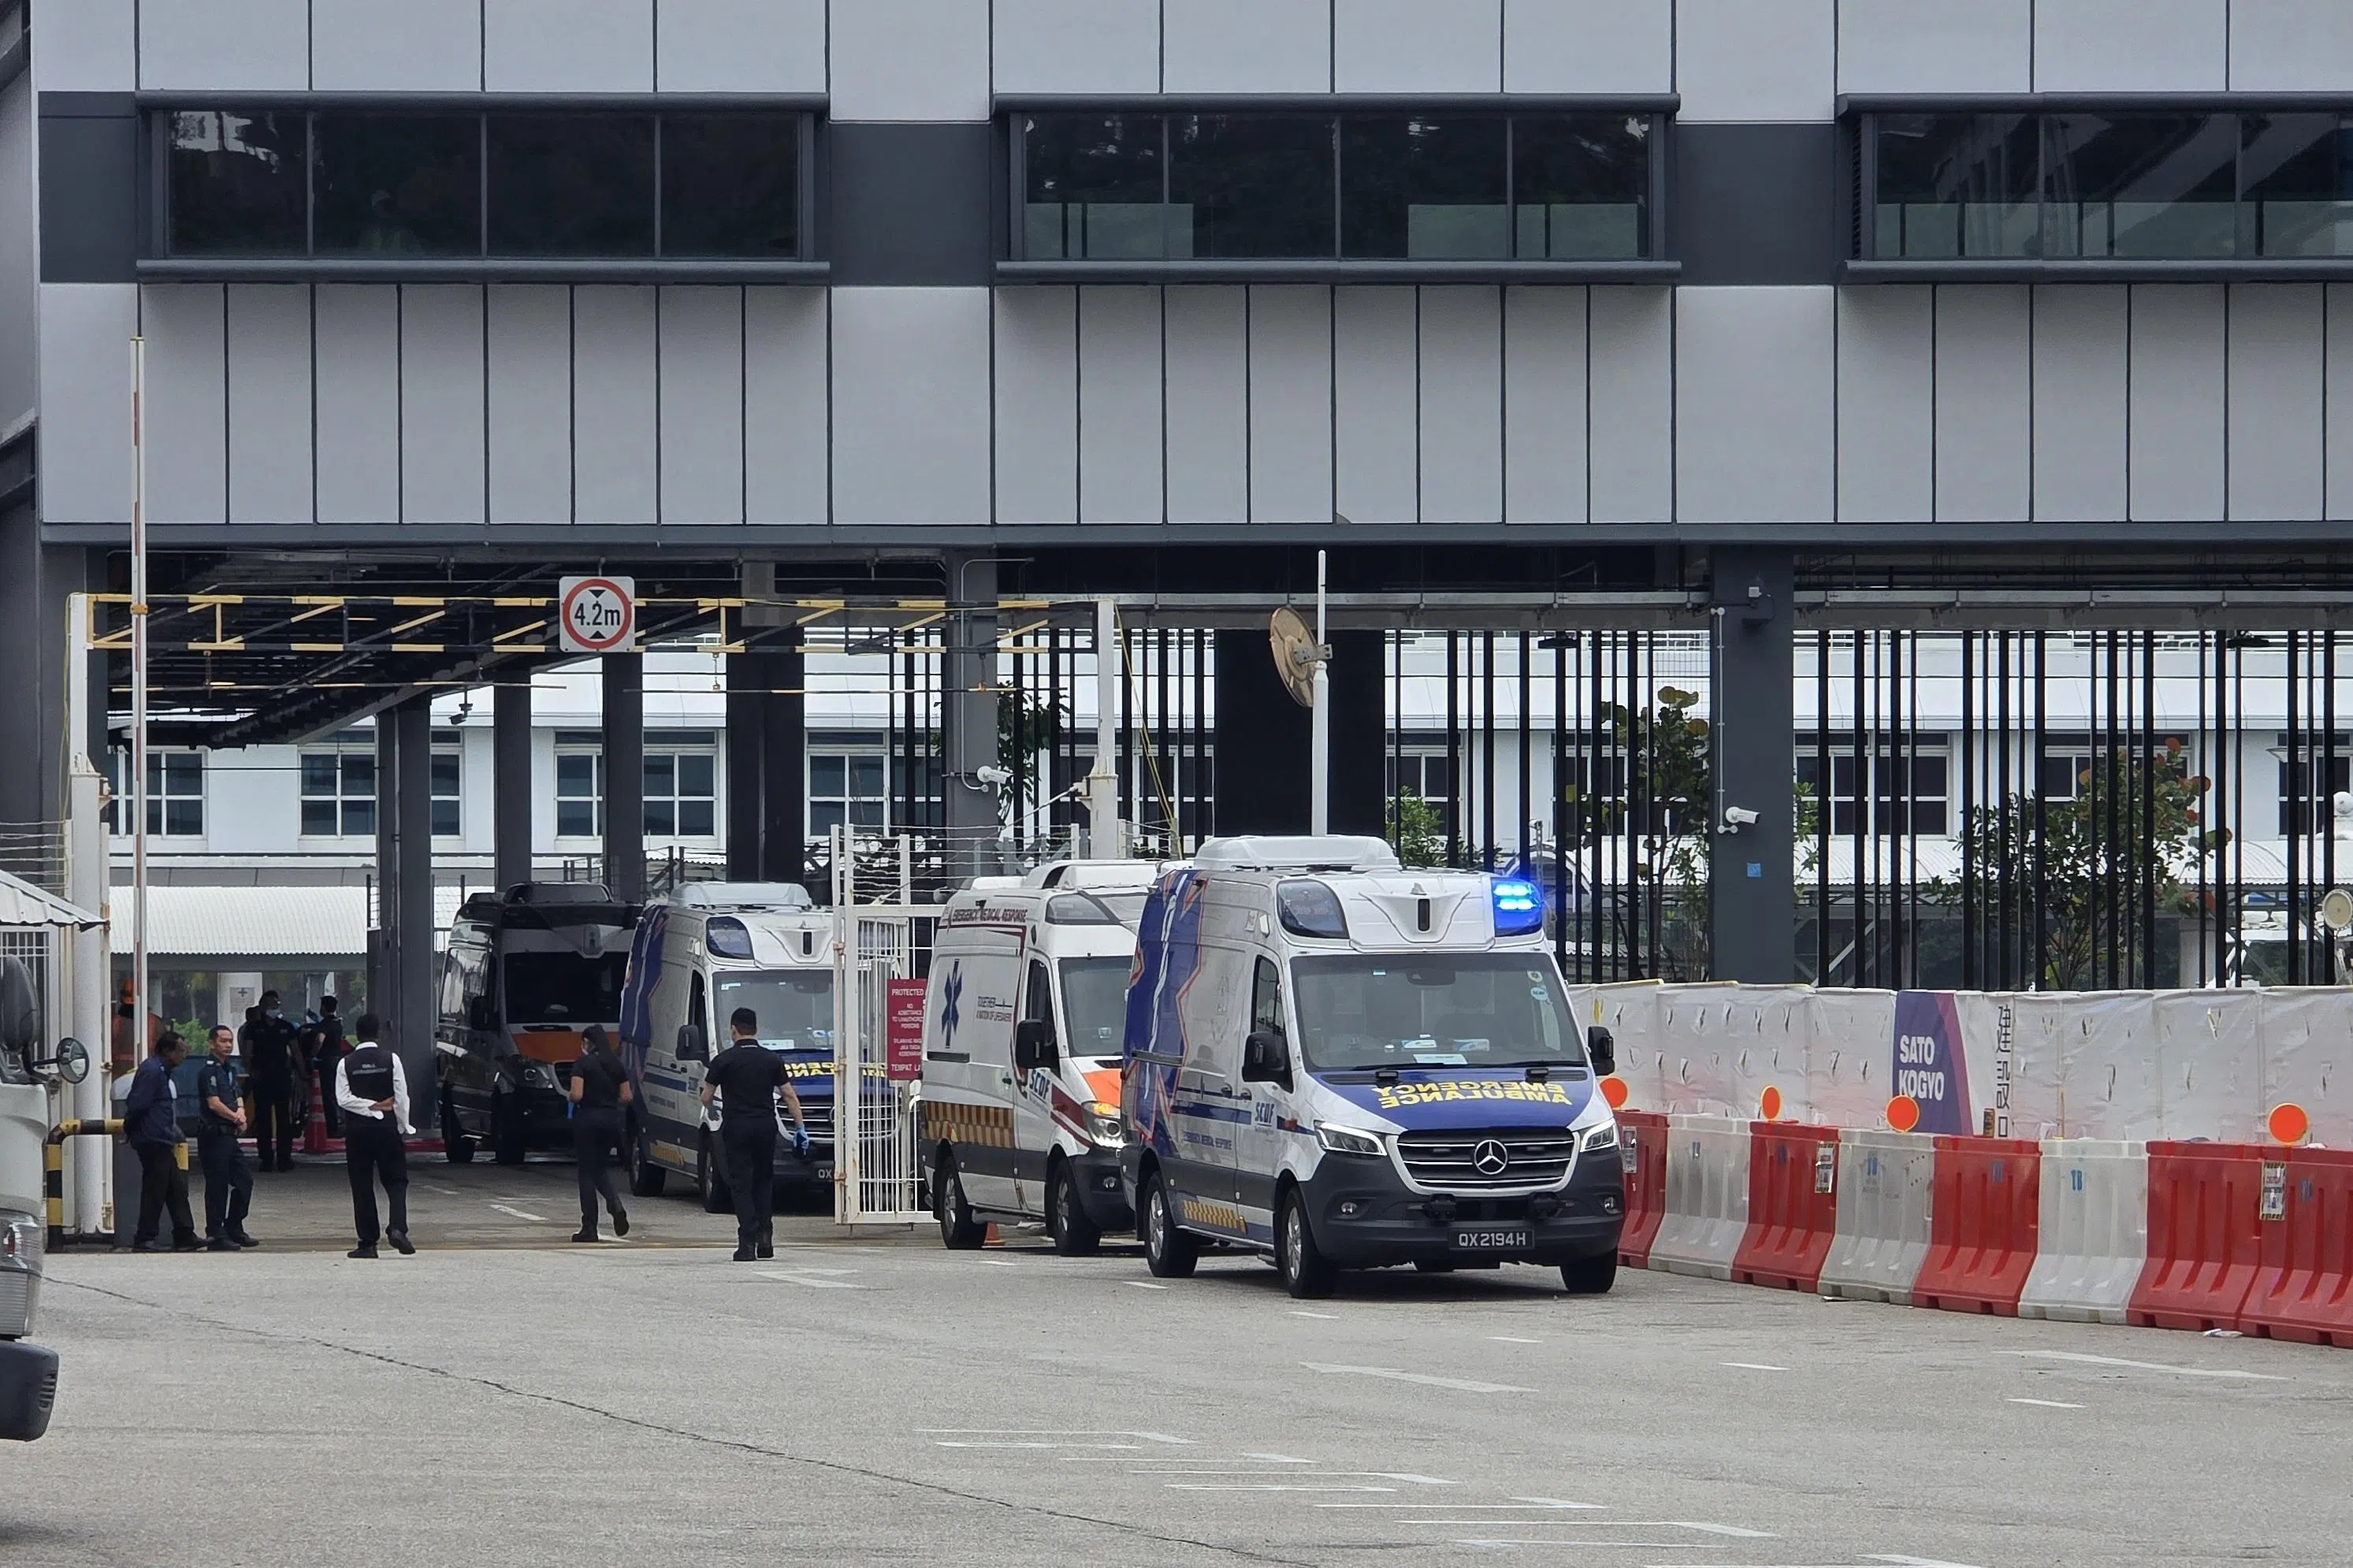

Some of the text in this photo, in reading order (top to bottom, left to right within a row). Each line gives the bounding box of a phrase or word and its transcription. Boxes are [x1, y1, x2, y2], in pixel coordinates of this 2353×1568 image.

[574, 602, 620, 626] 4.2m
[1899, 1035, 1935, 1065] SATO
[1029, 1068, 1050, 1100] SCDF
[1898, 1069, 1945, 1101] KOGYO
[1255, 1102, 1275, 1124] SCDF
[818, 1169, 832, 1179] QX
[1459, 1232, 1526, 1247] QX2194H
